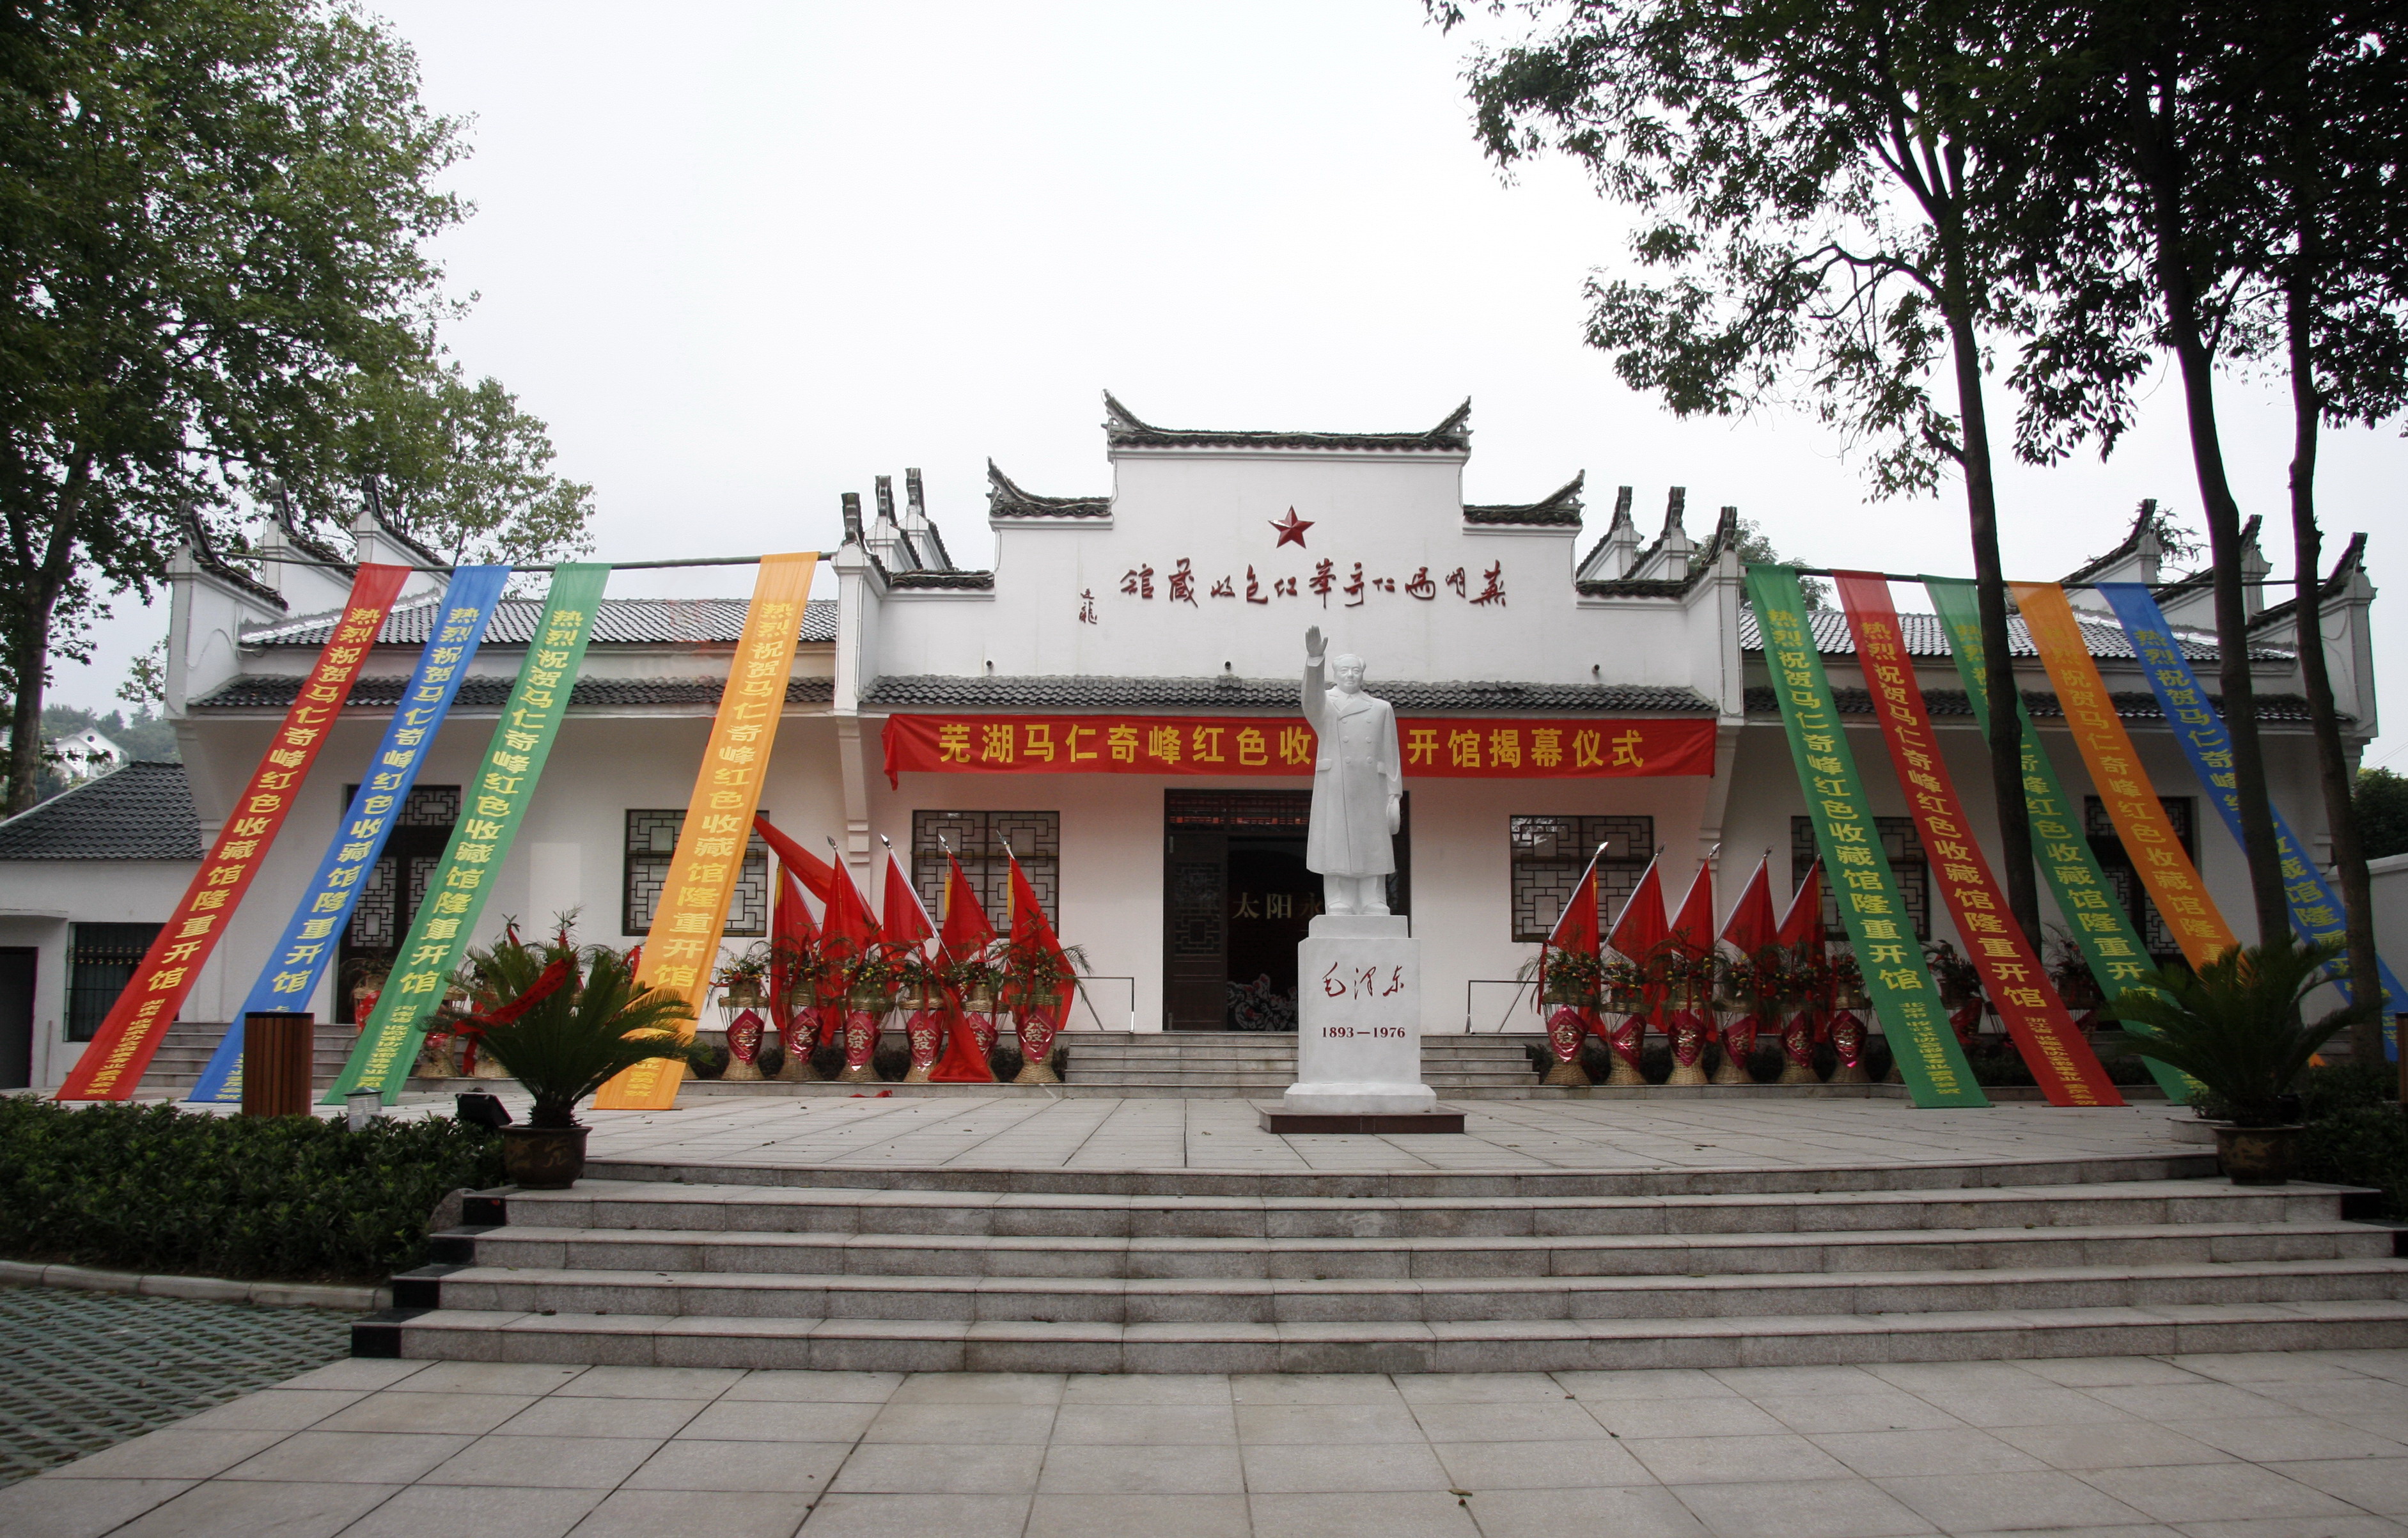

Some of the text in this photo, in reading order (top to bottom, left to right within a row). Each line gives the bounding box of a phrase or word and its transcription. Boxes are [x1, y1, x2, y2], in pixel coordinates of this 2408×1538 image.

[148, 608, 382, 993] 热烈祝贺马仁奇峰红色收藏馆隆重开馆
[272, 608, 480, 994] 热烈祝贺马仁奇峰红色收藏馆隆重开馆
[400, 609, 584, 995] 热烈祝贺马仁奇峰红色收藏馆隆重开馆
[654, 603, 793, 988] 热烈祝贺马仁奇峰红色收藏馆隆重开馆
[1766, 609, 1923, 991] 热烈祝贺马仁奇峰红色收藏馆隆重开馆
[1862, 622, 2047, 1008] 热烈祝贺马仁奇峰红色收藏馆隆重开馆
